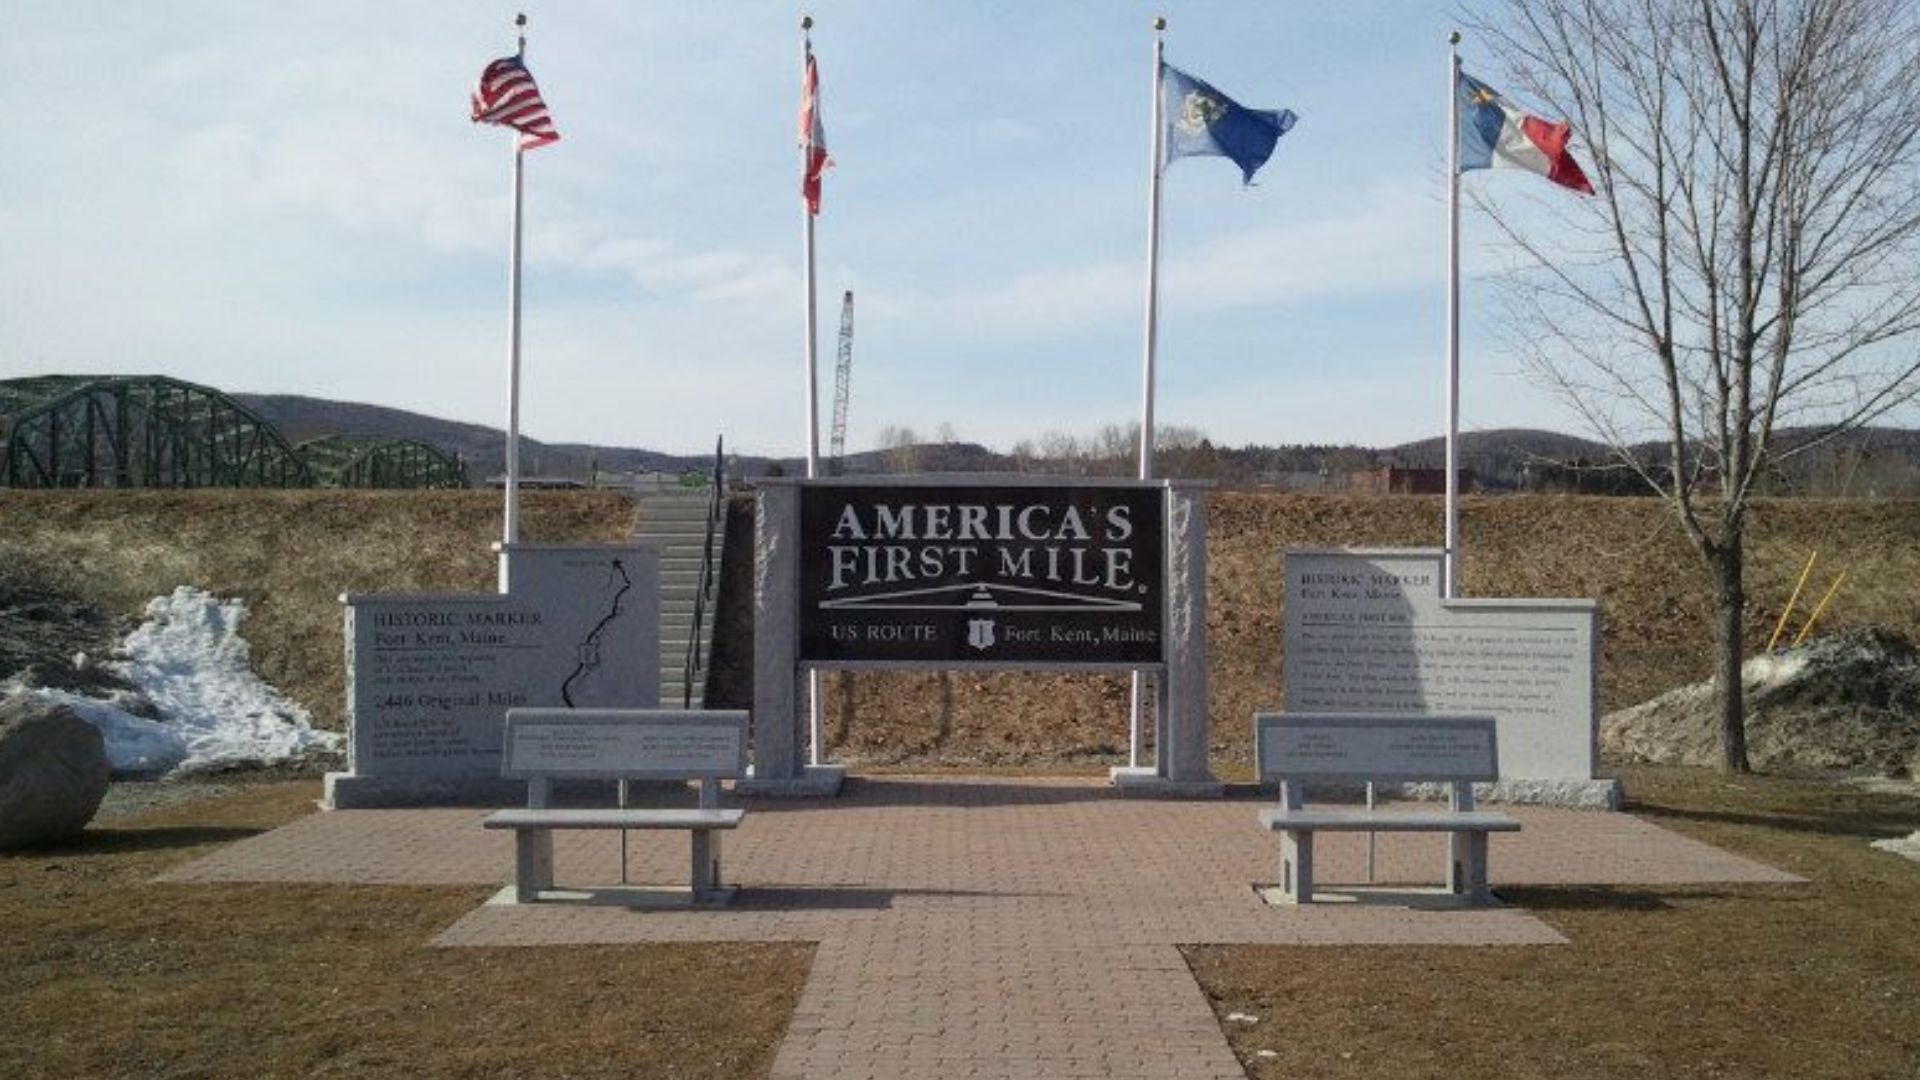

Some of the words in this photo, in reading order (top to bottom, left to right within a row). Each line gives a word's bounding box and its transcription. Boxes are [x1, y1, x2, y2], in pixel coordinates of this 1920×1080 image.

[831, 503, 1134, 541] AMERICA'S
[825, 546, 978, 591] FIRST
[374, 611, 460, 627] HISTORIC
[467, 613, 544, 626] MARKER
[374, 632, 406, 645] Fort
[460, 630, 506, 645] Maine
[831, 624, 858, 642] US
[867, 624, 937, 642] ROUTE
[1004, 624, 1042, 643] Fort
[1050, 625, 1100, 645] Kent,
[1102, 625, 1157, 643] Maine
[417, 693, 480, 710] Original
[487, 690, 528, 706] Miles
